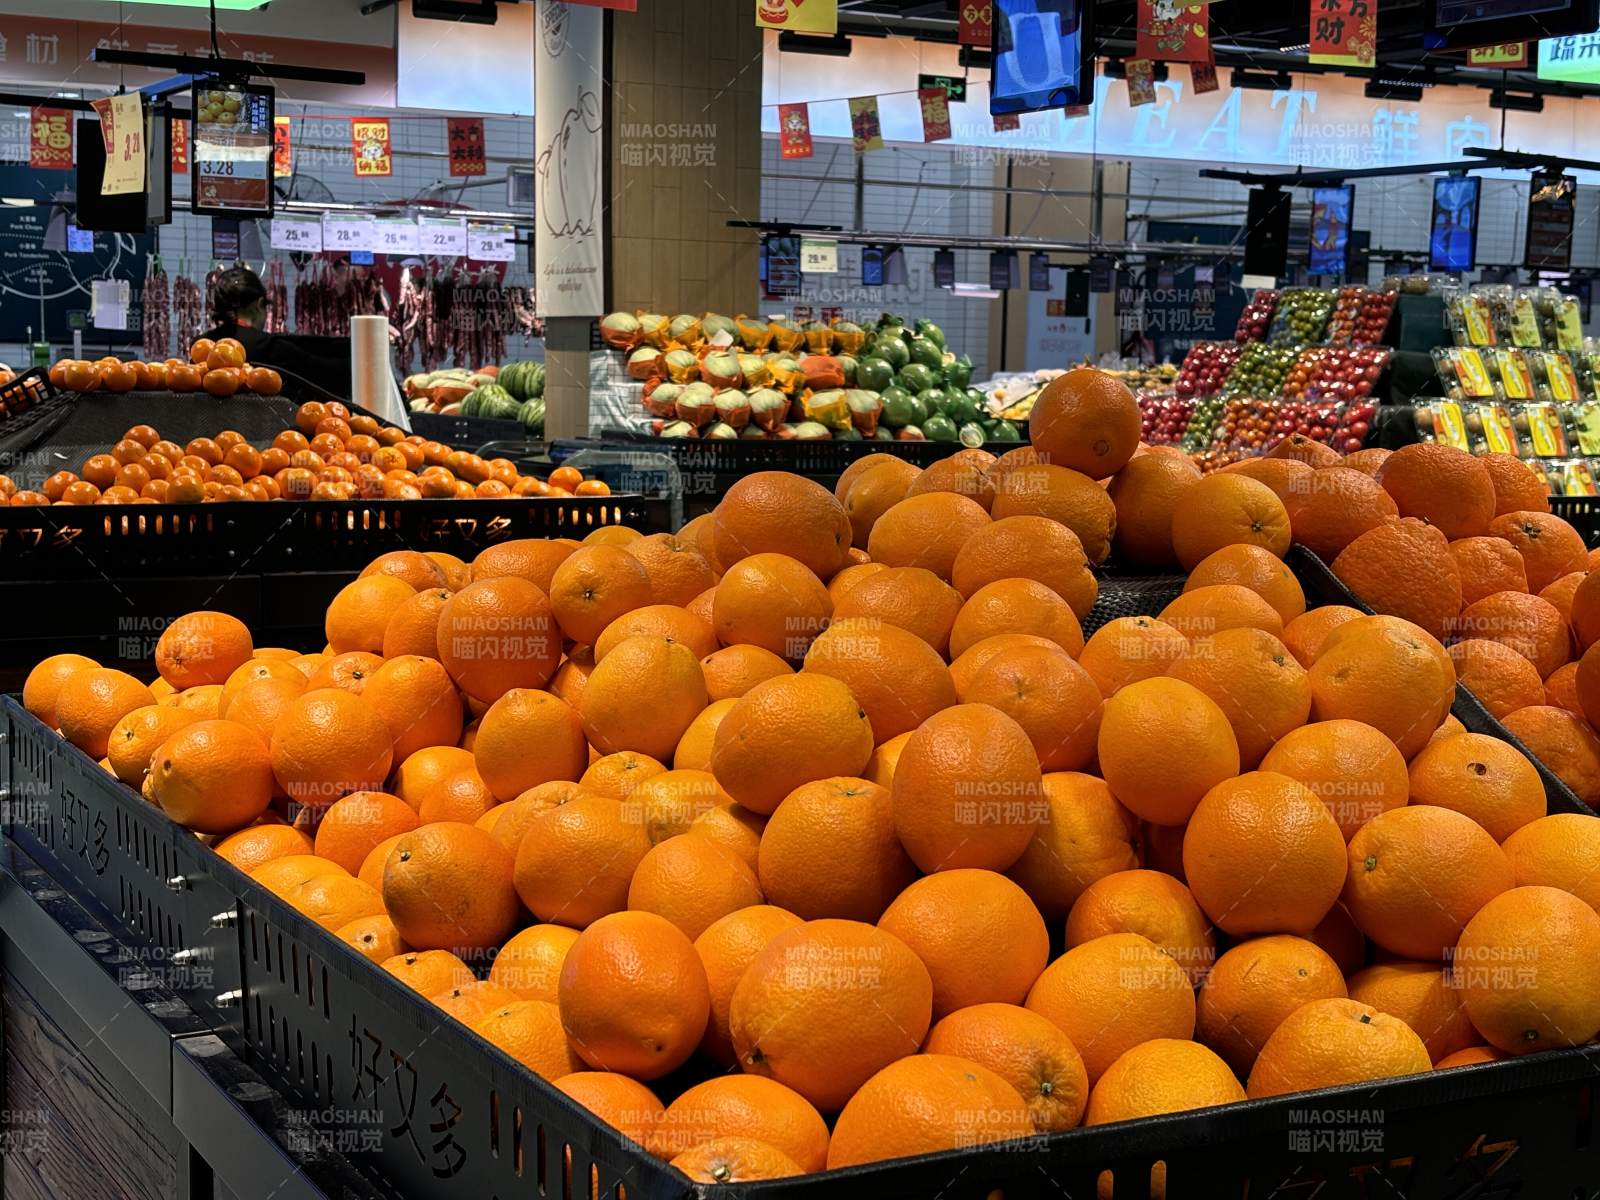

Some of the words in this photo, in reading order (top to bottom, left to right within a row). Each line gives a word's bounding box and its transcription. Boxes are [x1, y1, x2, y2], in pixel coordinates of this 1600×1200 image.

[32, 114, 72, 150] 福
[202, 160, 235, 176] 3.28
[60, 779, 110, 875] 好又多
[348, 1013, 467, 1179] 好又多
